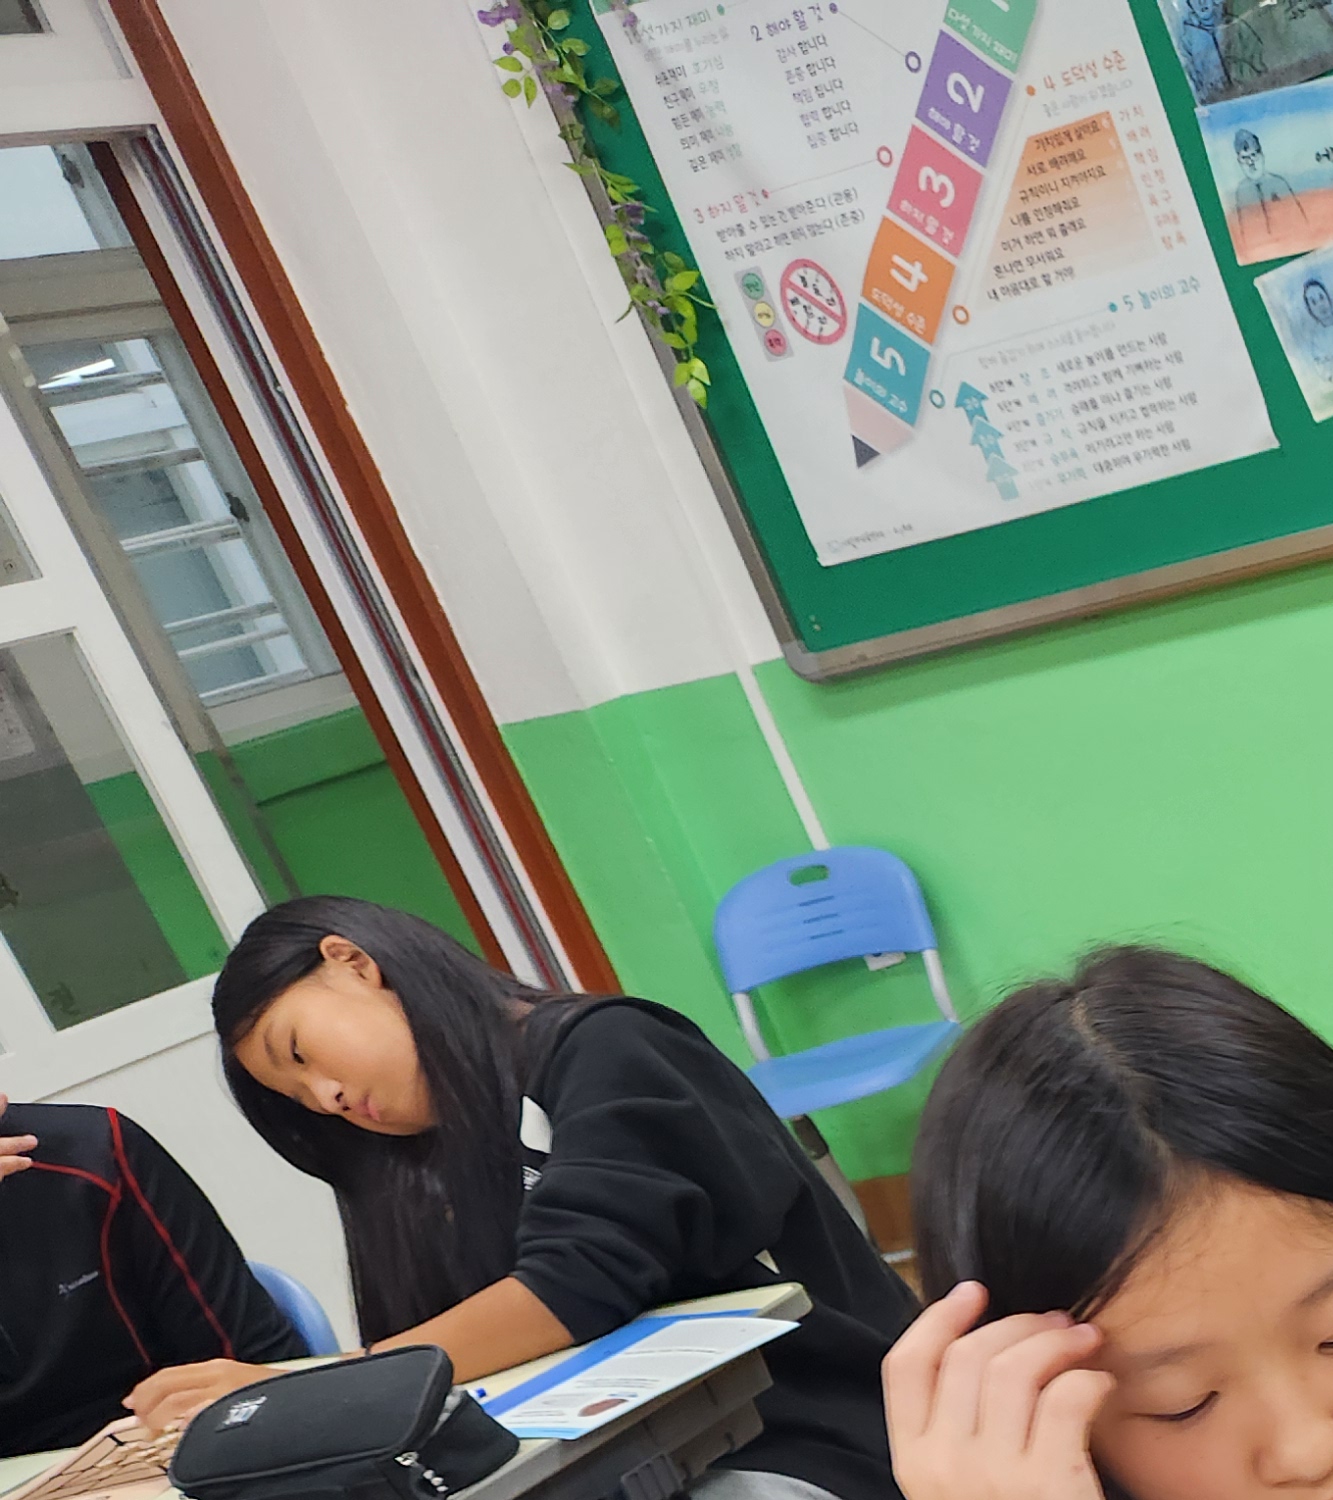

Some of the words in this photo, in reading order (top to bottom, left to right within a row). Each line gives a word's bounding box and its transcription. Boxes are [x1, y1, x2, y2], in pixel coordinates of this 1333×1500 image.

[750, 24, 763, 42] 2
[765, 18, 791, 37] 해야
[792, 9, 807, 31] 할
[807, 5, 824, 21] 것
[775, 45, 797, 64] 감사
[797, 34, 828, 56] 합니다
[805, 56, 836, 77] 합니다
[1043, 75, 1056, 90] 4
[1061, 61, 1098, 87] 도덕성
[1103, 49, 1126, 72] 수준
[946, 72, 985, 114] 2
[821, 99, 851, 120] 합니다
[828, 121, 859, 142] 합니다
[1026, 161, 1046, 175] 서로
[917, 165, 956, 209] 3
[1019, 180, 1059, 202] 규칙이니
[693, 207, 705, 225] 3
[707, 201, 732, 219] 하지
[1010, 211, 1032, 226] 나를
[1000, 237, 1024, 252] 이거
[1024, 230, 1044, 245] 하면
[889, 253, 929, 293] 4
[993, 259, 1024, 279] 혼나면
[988, 288, 999, 300] 내
[999, 276, 1039, 296] 마음대로
[1122, 294, 1134, 311] 5
[1137, 284, 1175, 310] 놀이의
[1178, 275, 1200, 294] 고수
[869, 336, 906, 377] 5
